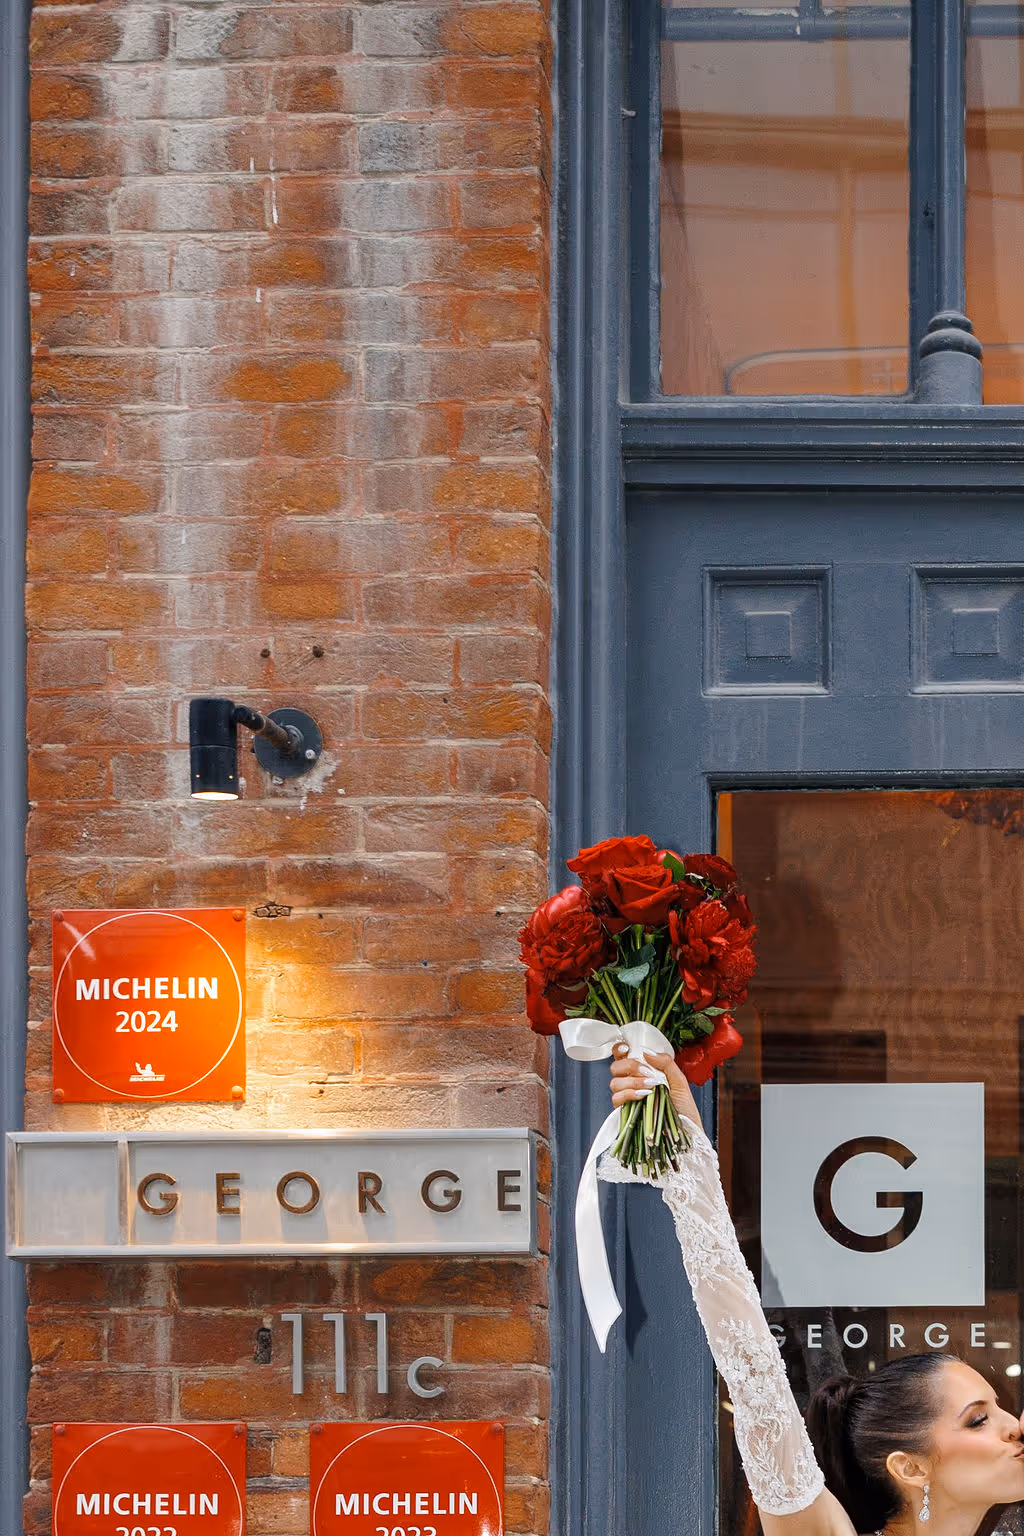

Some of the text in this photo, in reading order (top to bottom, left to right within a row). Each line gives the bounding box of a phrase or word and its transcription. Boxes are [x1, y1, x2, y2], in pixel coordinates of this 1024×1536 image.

[76, 977, 218, 1000] MICHELIN
[115, 1010, 178, 1033] 2024
[137, 1170, 522, 1216] GEORGE
[813, 1136, 924, 1253] G
[76, 1493, 219, 1515] MICHELIN
[335, 1493, 478, 1515] MICHELIN
